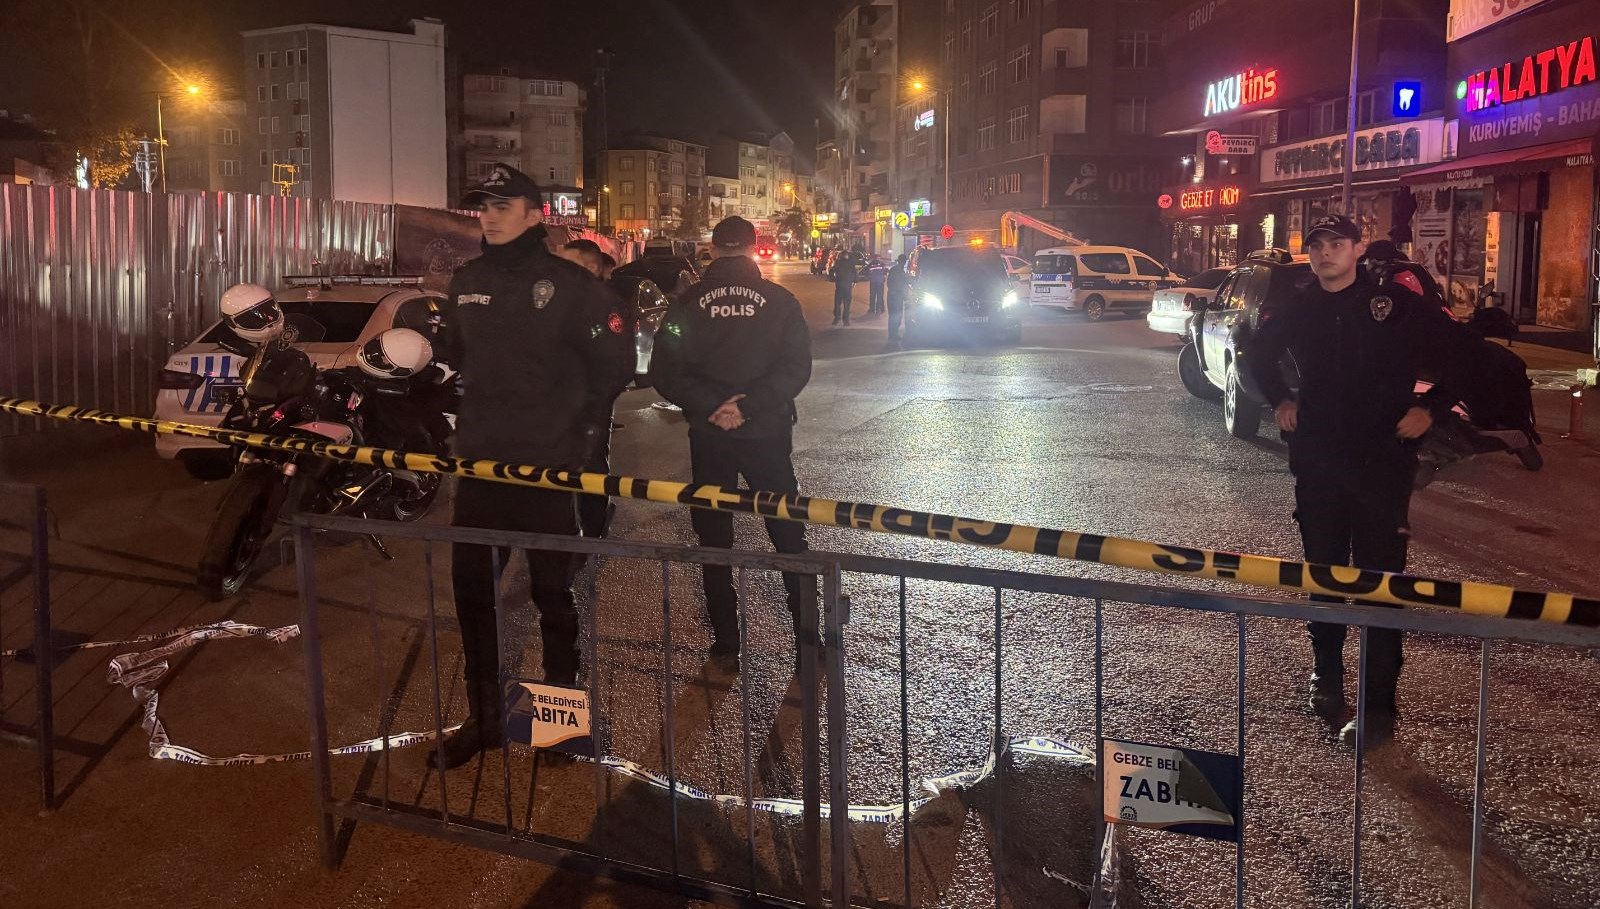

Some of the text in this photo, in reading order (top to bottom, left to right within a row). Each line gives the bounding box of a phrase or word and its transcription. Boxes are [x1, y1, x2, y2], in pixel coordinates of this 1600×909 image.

[1465, 36, 1596, 113] MALATYA
[1469, 111, 1542, 143] KURUYEMİŞ
[699, 283, 767, 309] ÇEVİK KUVVET
[711, 304, 755, 318] POLİS
[538, 694, 586, 709] BELEDİYESİ
[532, 705, 579, 727] ABITA
[1113, 751, 1153, 768] GEBZE
